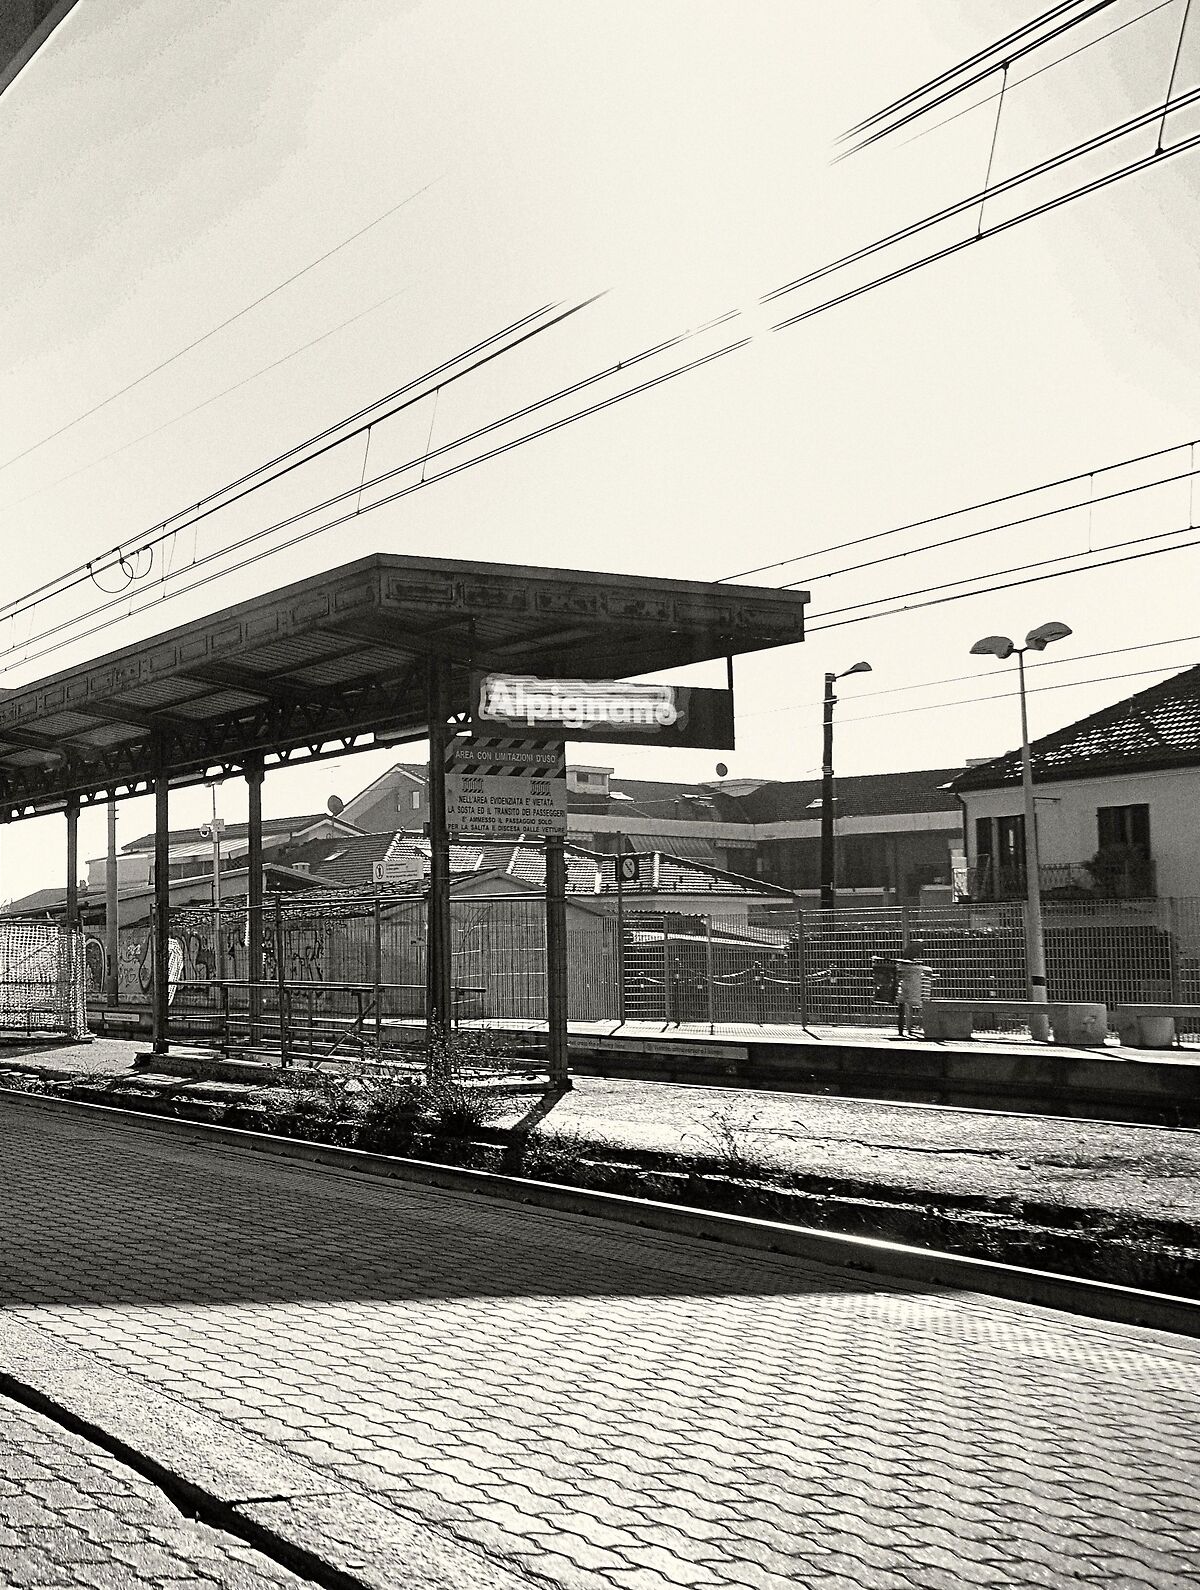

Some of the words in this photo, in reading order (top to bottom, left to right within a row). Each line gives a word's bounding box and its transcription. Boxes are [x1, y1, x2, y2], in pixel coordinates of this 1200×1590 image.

[487, 680, 677, 729] Alpignano
[455, 750, 474, 759] AREA
[477, 751, 492, 760] CON
[494, 752, 534, 762] LIMITAZIONI
[536, 754, 556, 763] D'USO
[459, 796, 488, 805] NELL'AREA
[490, 797, 523, 806] EVIDENZIATA
[532, 798, 554, 806] VIETATA
[447, 806, 455, 814] LA
[457, 806, 475, 814] SOSTA
[477, 807, 485, 815] ED
[487, 807, 492, 815] IL
[494, 807, 520, 816] TRANSITO
[521, 808, 531, 817] DEI
[505, 817, 536, 825] PASSAGGIO
